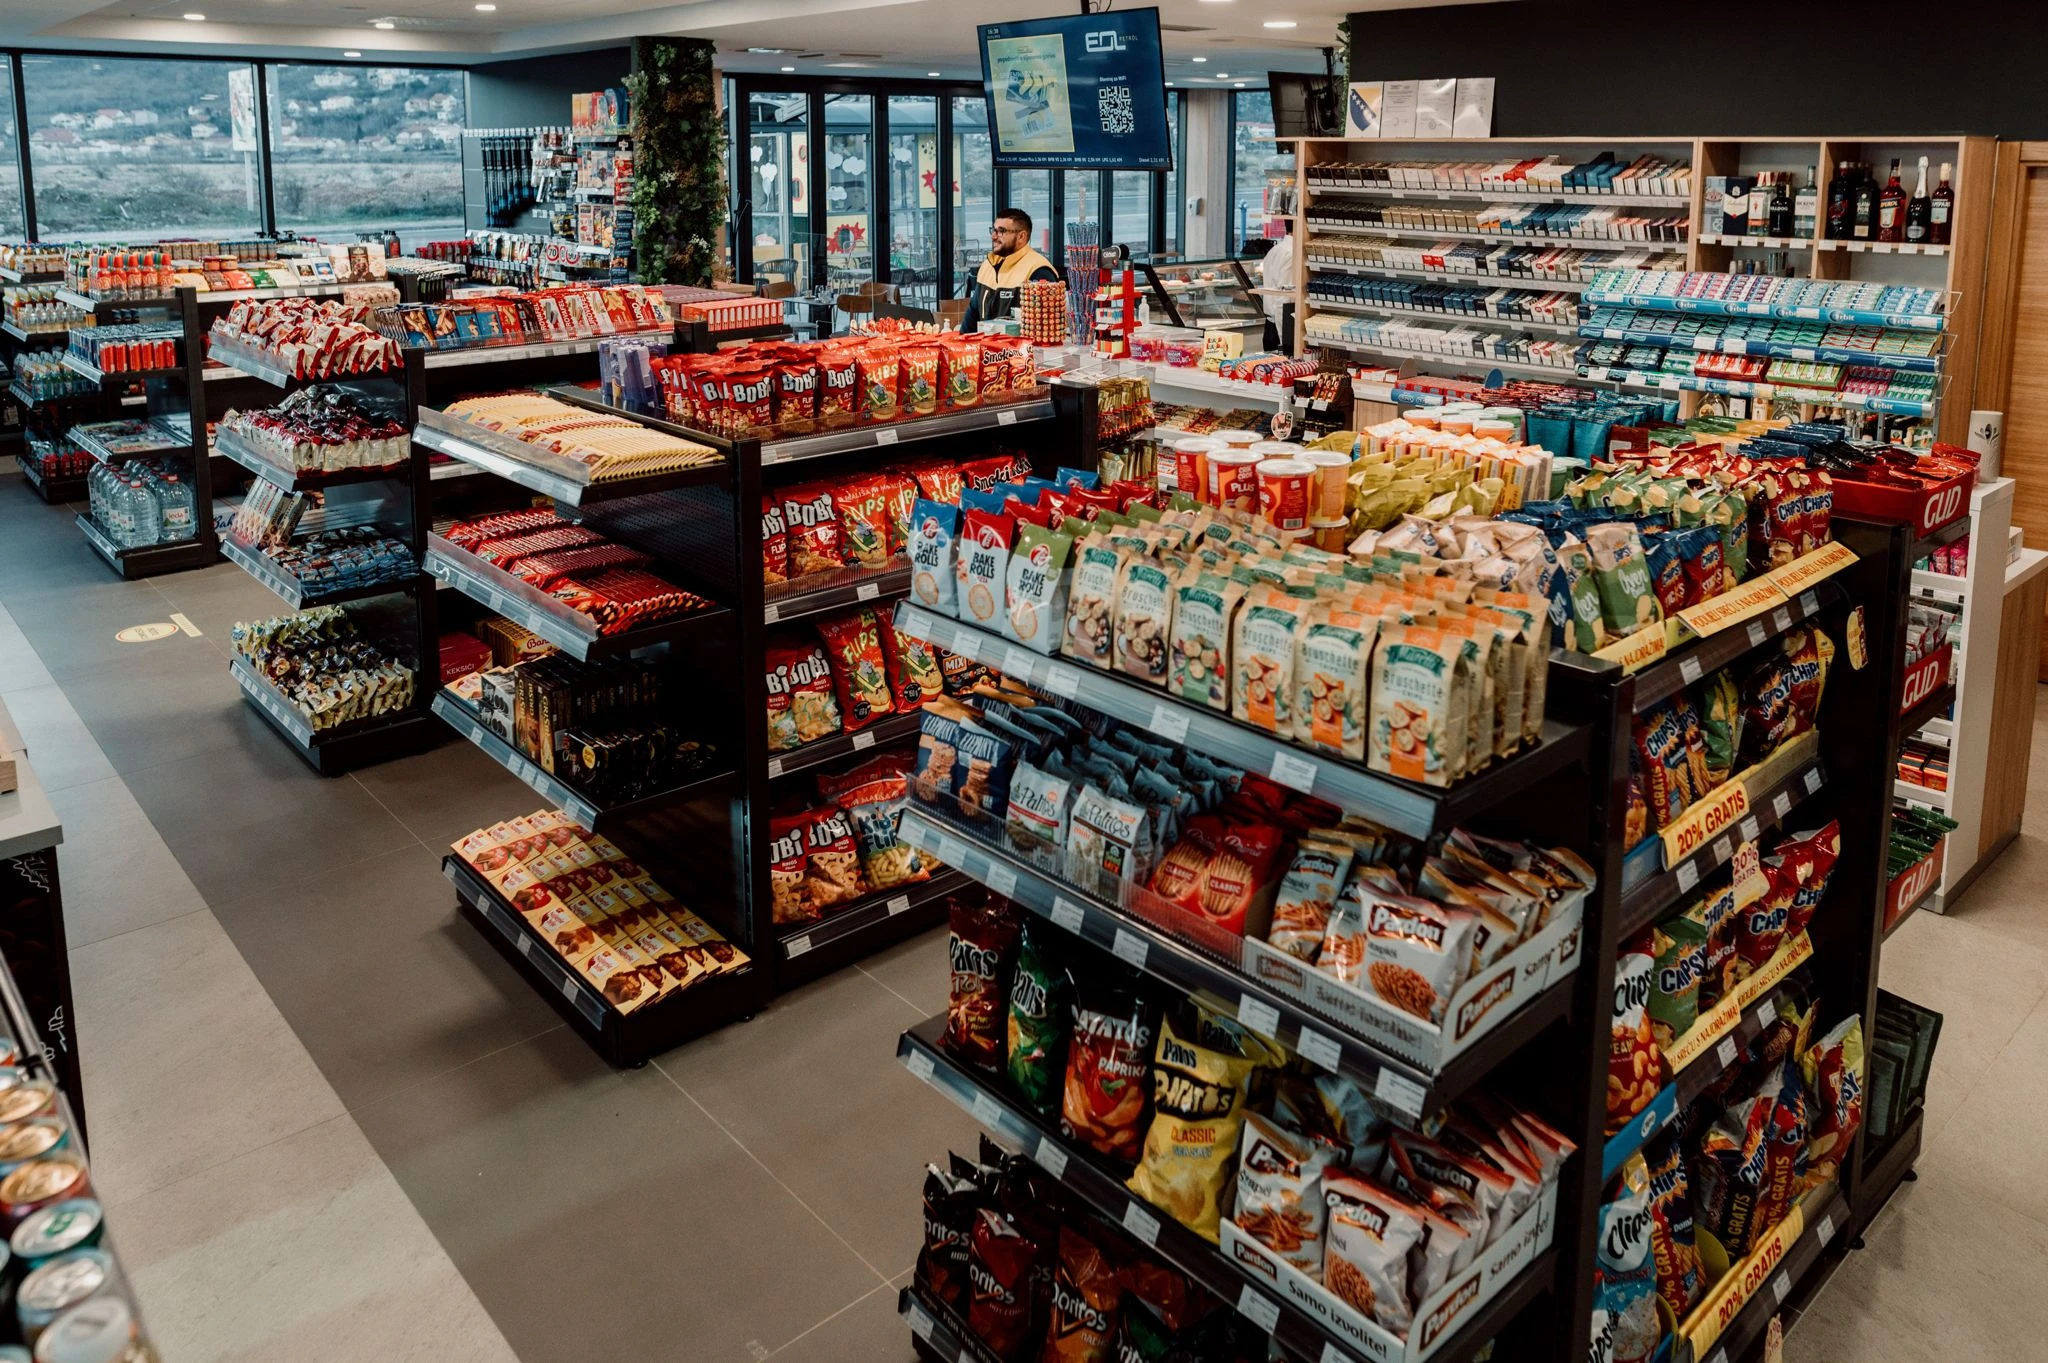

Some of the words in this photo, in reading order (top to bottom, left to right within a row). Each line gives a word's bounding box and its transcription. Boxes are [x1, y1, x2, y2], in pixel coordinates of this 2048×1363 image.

[1829, 310, 1855, 322] Orbit
[950, 355, 979, 373] FLIPS
[1867, 399, 1895, 411] Orbit
[1924, 484, 1962, 529] GUD
[915, 552, 939, 567] ROLLS
[969, 562, 995, 580] ROLLS
[973, 552, 995, 567] BAKE
[1022, 568, 1046, 585] BAKE
[1018, 580, 1043, 597] ROLLS
[843, 628, 878, 665] FLIPS
[945, 657, 965, 672] MIX
[1901, 661, 1939, 709] GUD
[1652, 765, 1665, 807] GRATIS
[1088, 803, 1131, 839] Palitos
[1677, 820, 1704, 857] 20%
[1705, 790, 1745, 834] GRATIS
[1733, 842, 1759, 876] 20%
[1209, 879, 1242, 895] CLASSIC
[1898, 858, 1933, 911] GUD
[1373, 906, 1441, 942] Pardon
[1171, 1126, 1216, 1144] CLASSIC
[1771, 1155, 1790, 1200] GRATIS
[1727, 1192, 1751, 1236] GRATIS
[969, 1264, 1015, 1304] oritos
[1237, 1242, 1275, 1275] Pardon
[1288, 1279, 1327, 1316] Samo
[1719, 1286, 1743, 1330] 20%
[1745, 1236, 1782, 1295] GRATIS
